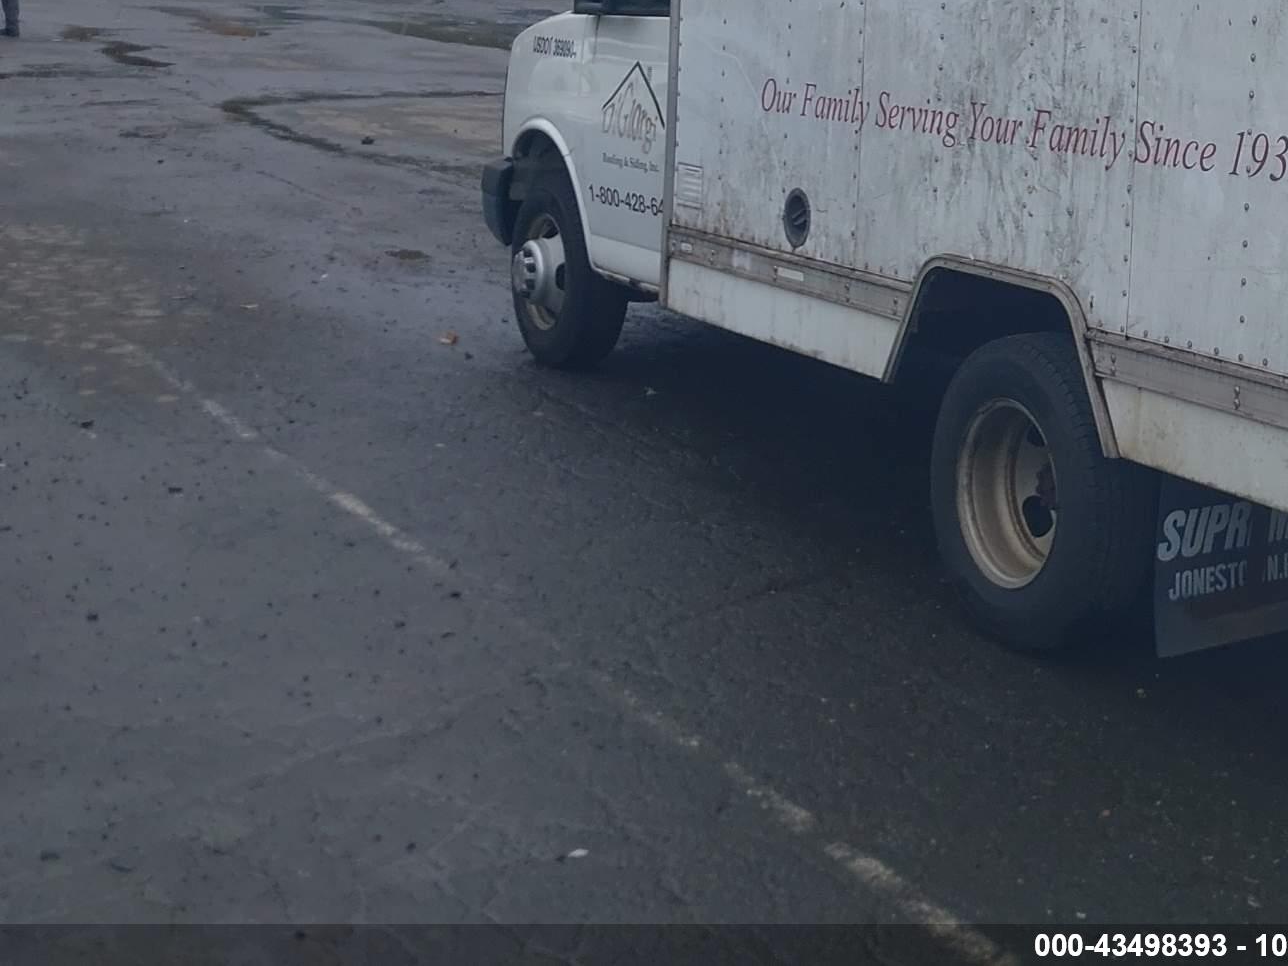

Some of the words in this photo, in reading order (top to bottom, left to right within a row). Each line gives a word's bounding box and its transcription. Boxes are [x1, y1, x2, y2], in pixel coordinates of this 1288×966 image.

[761, 78, 797, 113] Our
[800, 82, 870, 132] Family
[875, 91, 959, 148] Serving
[968, 101, 1023, 146] Your
[1028, 108, 1126, 171] Family
[1134, 120, 1217, 172] Since
